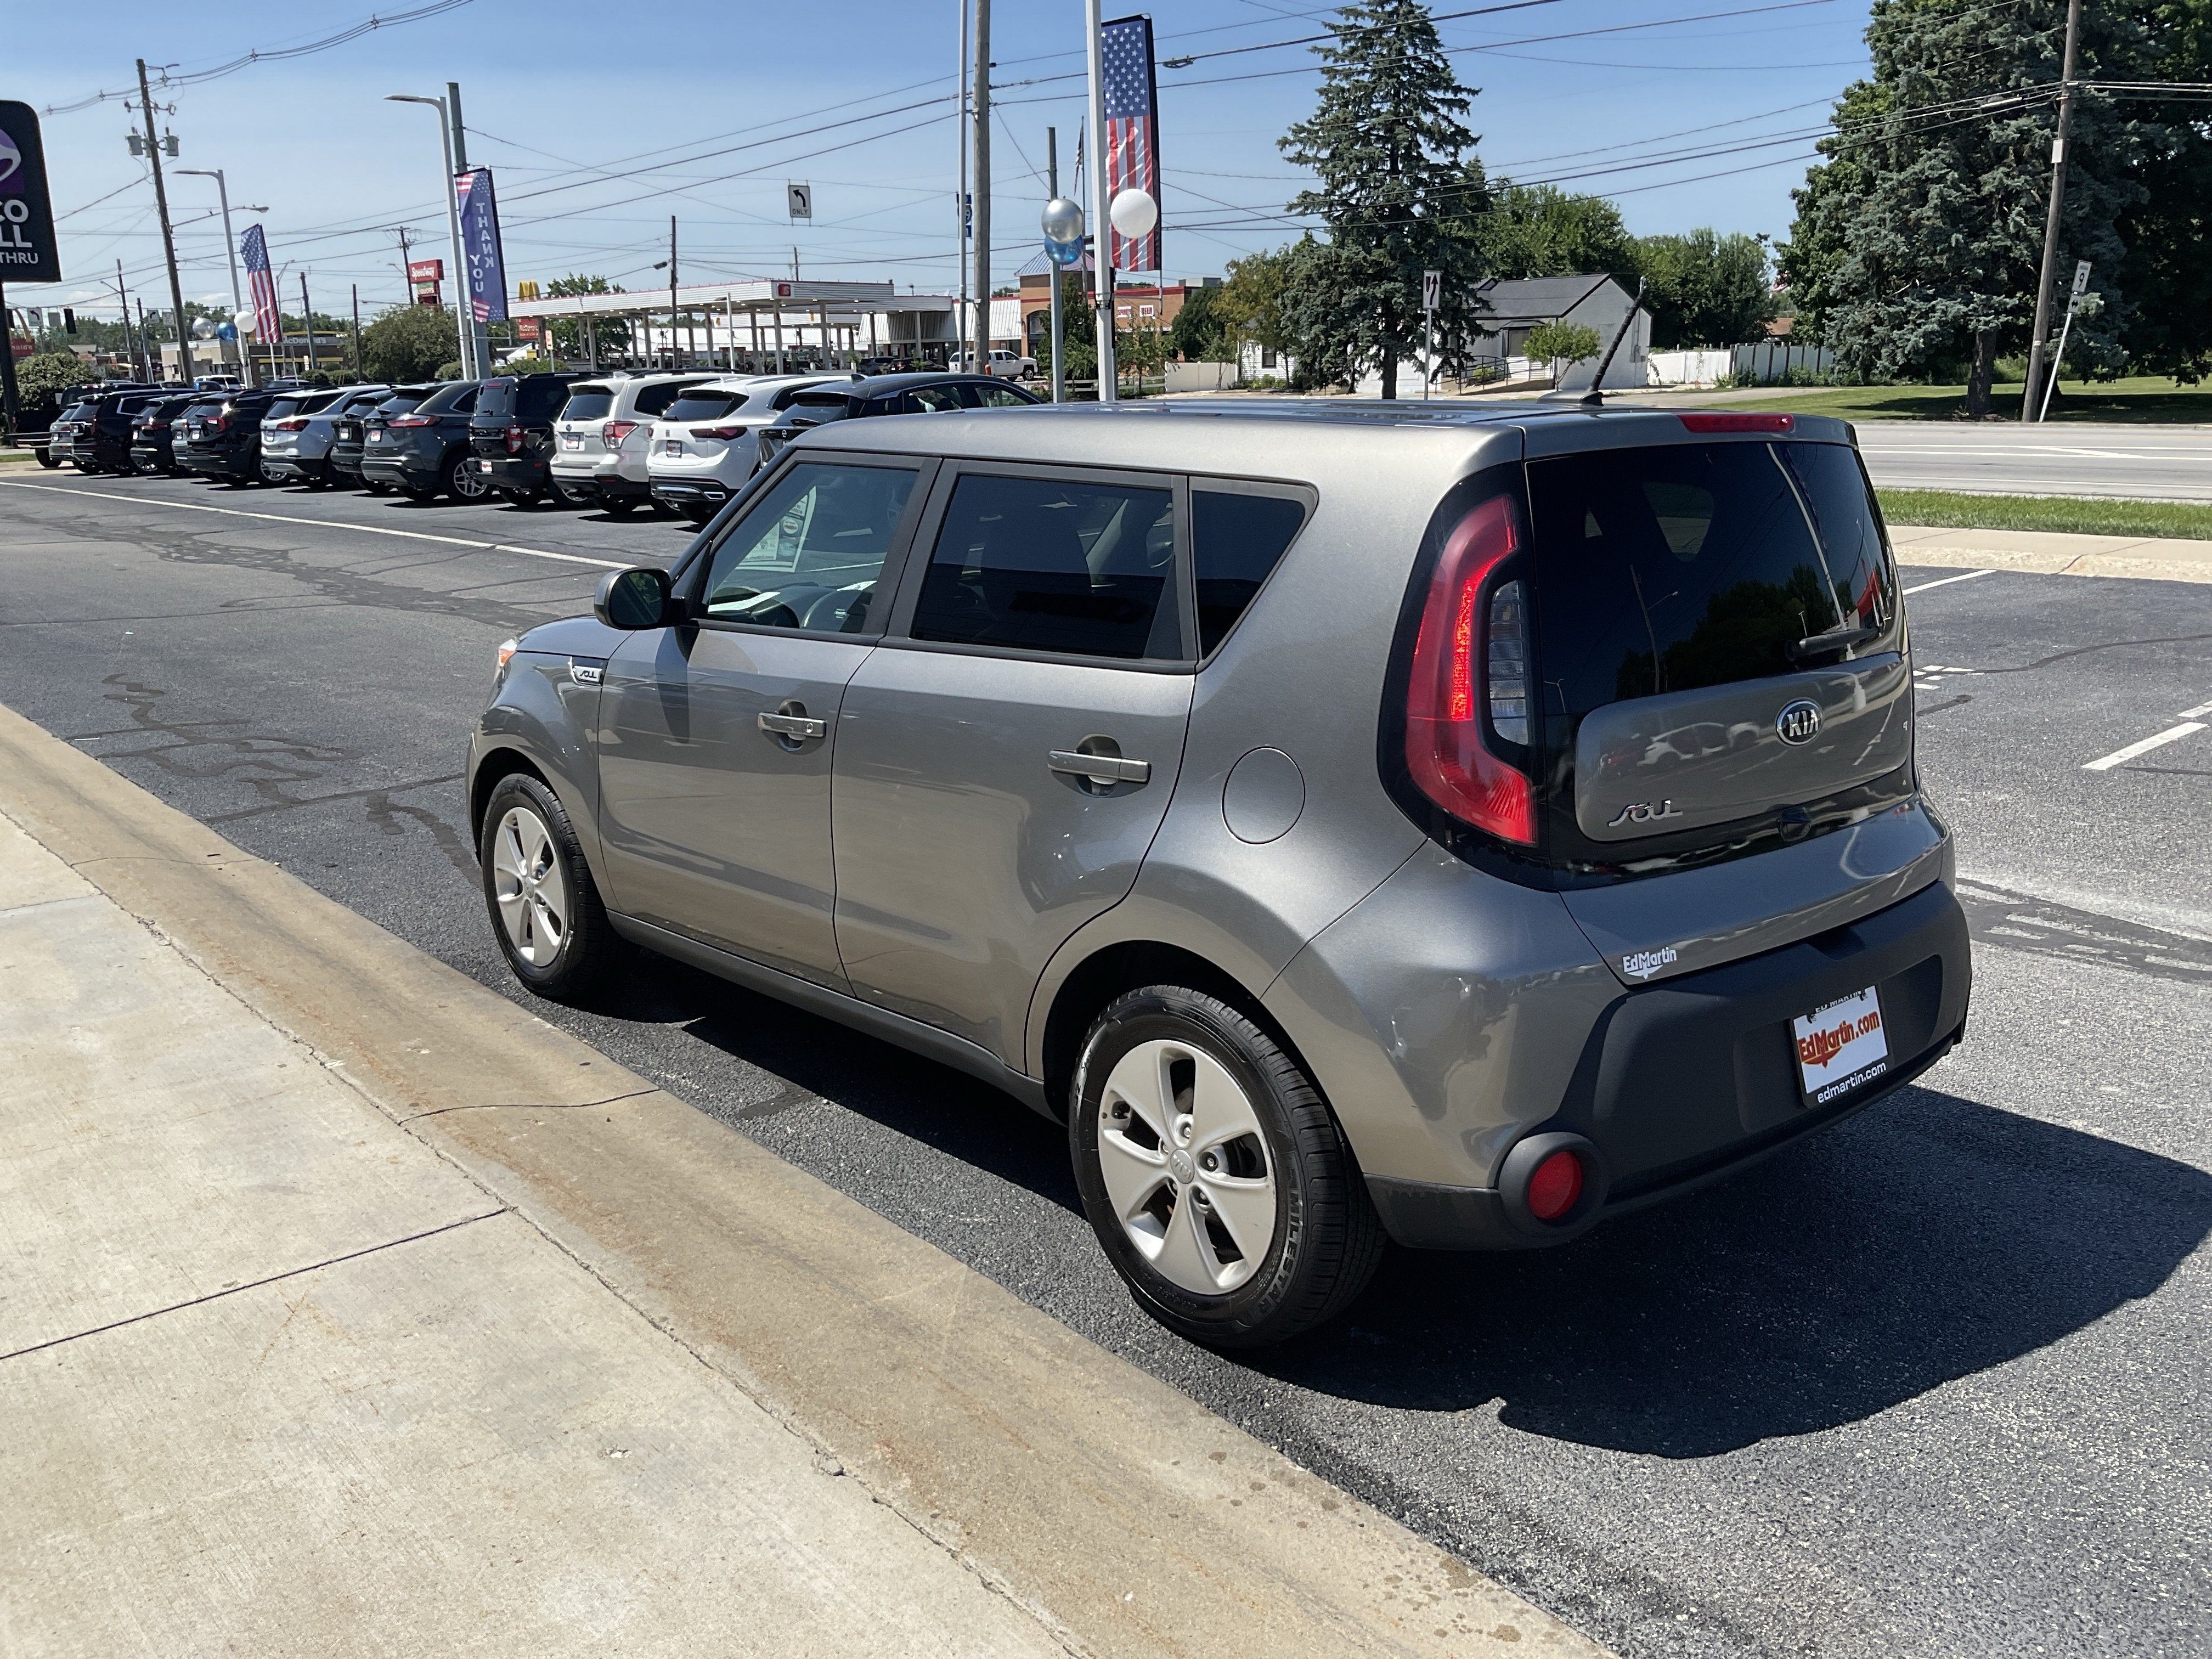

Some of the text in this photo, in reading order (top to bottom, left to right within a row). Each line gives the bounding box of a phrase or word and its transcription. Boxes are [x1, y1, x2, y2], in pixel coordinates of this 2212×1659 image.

[411, 266, 435, 280] Speedway
[1787, 709, 1819, 737] KIA
[1623, 946, 1677, 973] EdMartin
[1797, 1011, 1880, 1063] EdMartin.com
[1817, 1062, 1887, 1104] edmartin.com
[1258, 1190, 1300, 1314] MILESTAR
